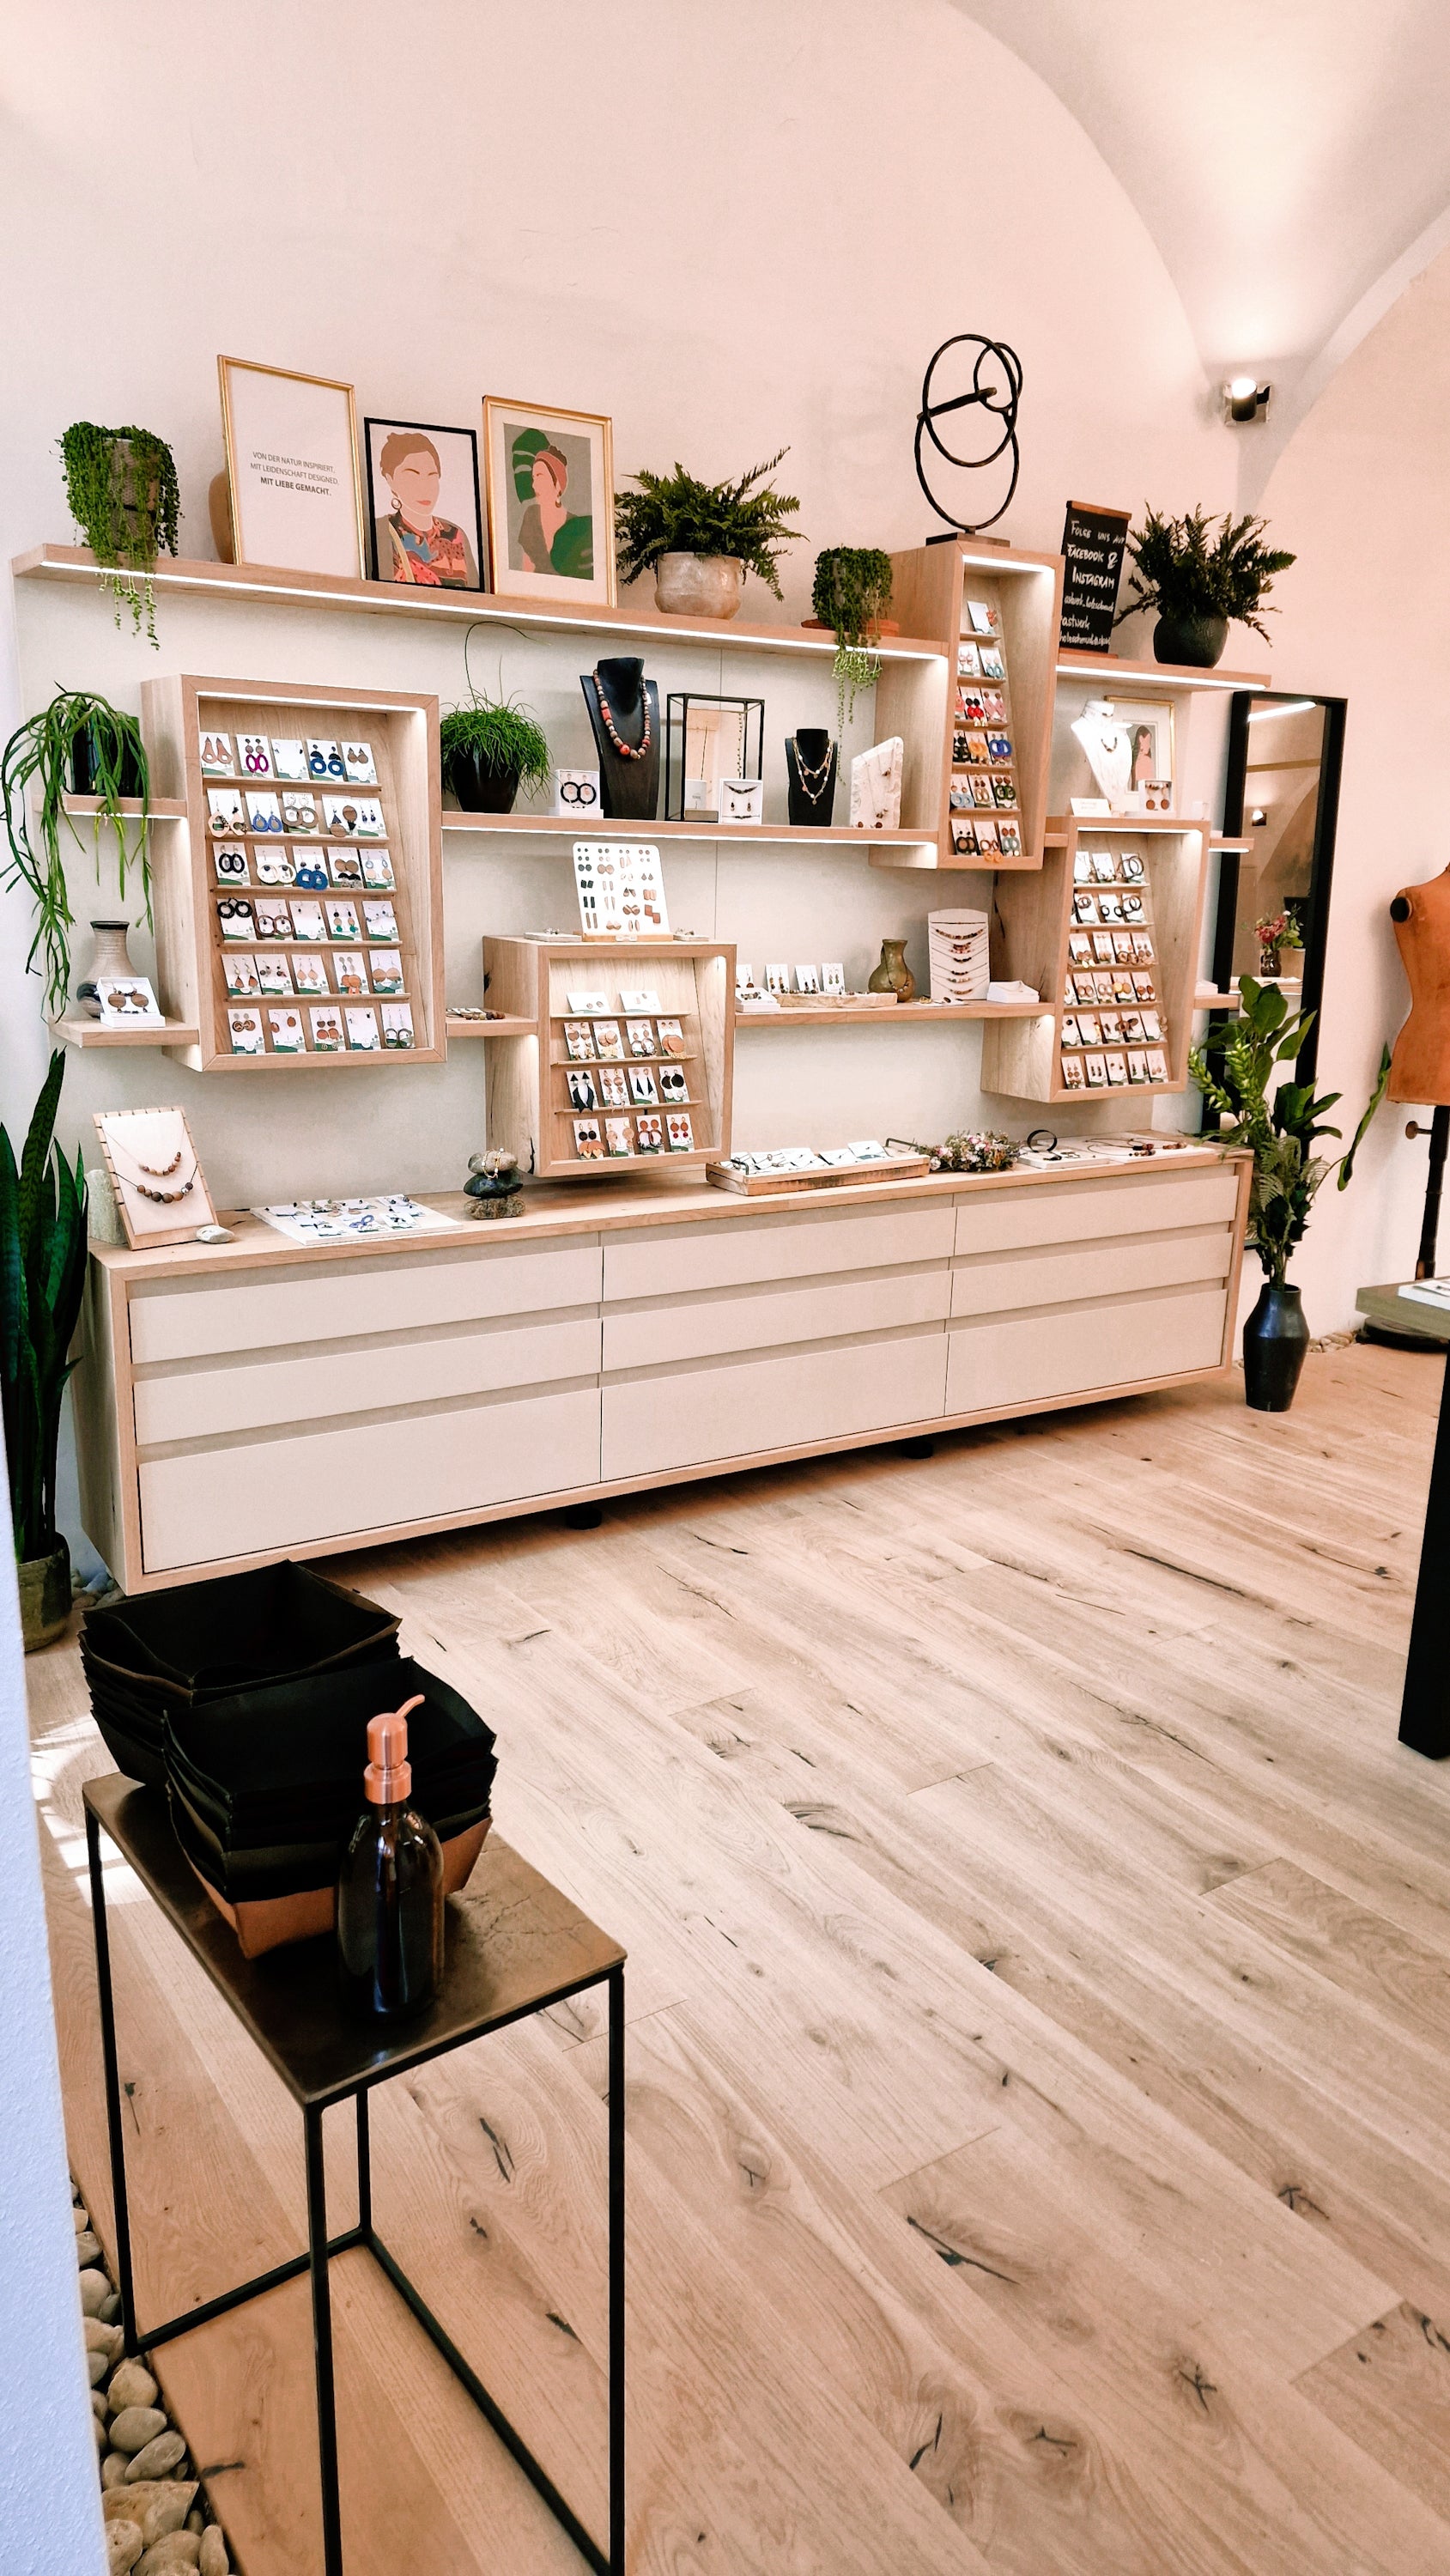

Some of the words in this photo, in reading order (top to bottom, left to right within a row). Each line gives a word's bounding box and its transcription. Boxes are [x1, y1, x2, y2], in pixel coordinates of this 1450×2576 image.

[252, 452, 267, 460] VON
[267, 454, 281, 463] DER
[281, 457, 302, 466] NATUR
[250, 462, 262, 471] MIT
[262, 465, 307, 479] LEIDENSCHAFT
[260, 477, 274, 485] MIT
[275, 480, 294, 489] LIEBE
[295, 483, 332, 496] GEMACHT.
[1071, 520, 1092, 539] FOLGE
[1067, 543, 1105, 563] FACEBOOK
[1107, 551, 1119, 569] &
[1071, 565, 1115, 590] INSTAGRAM
